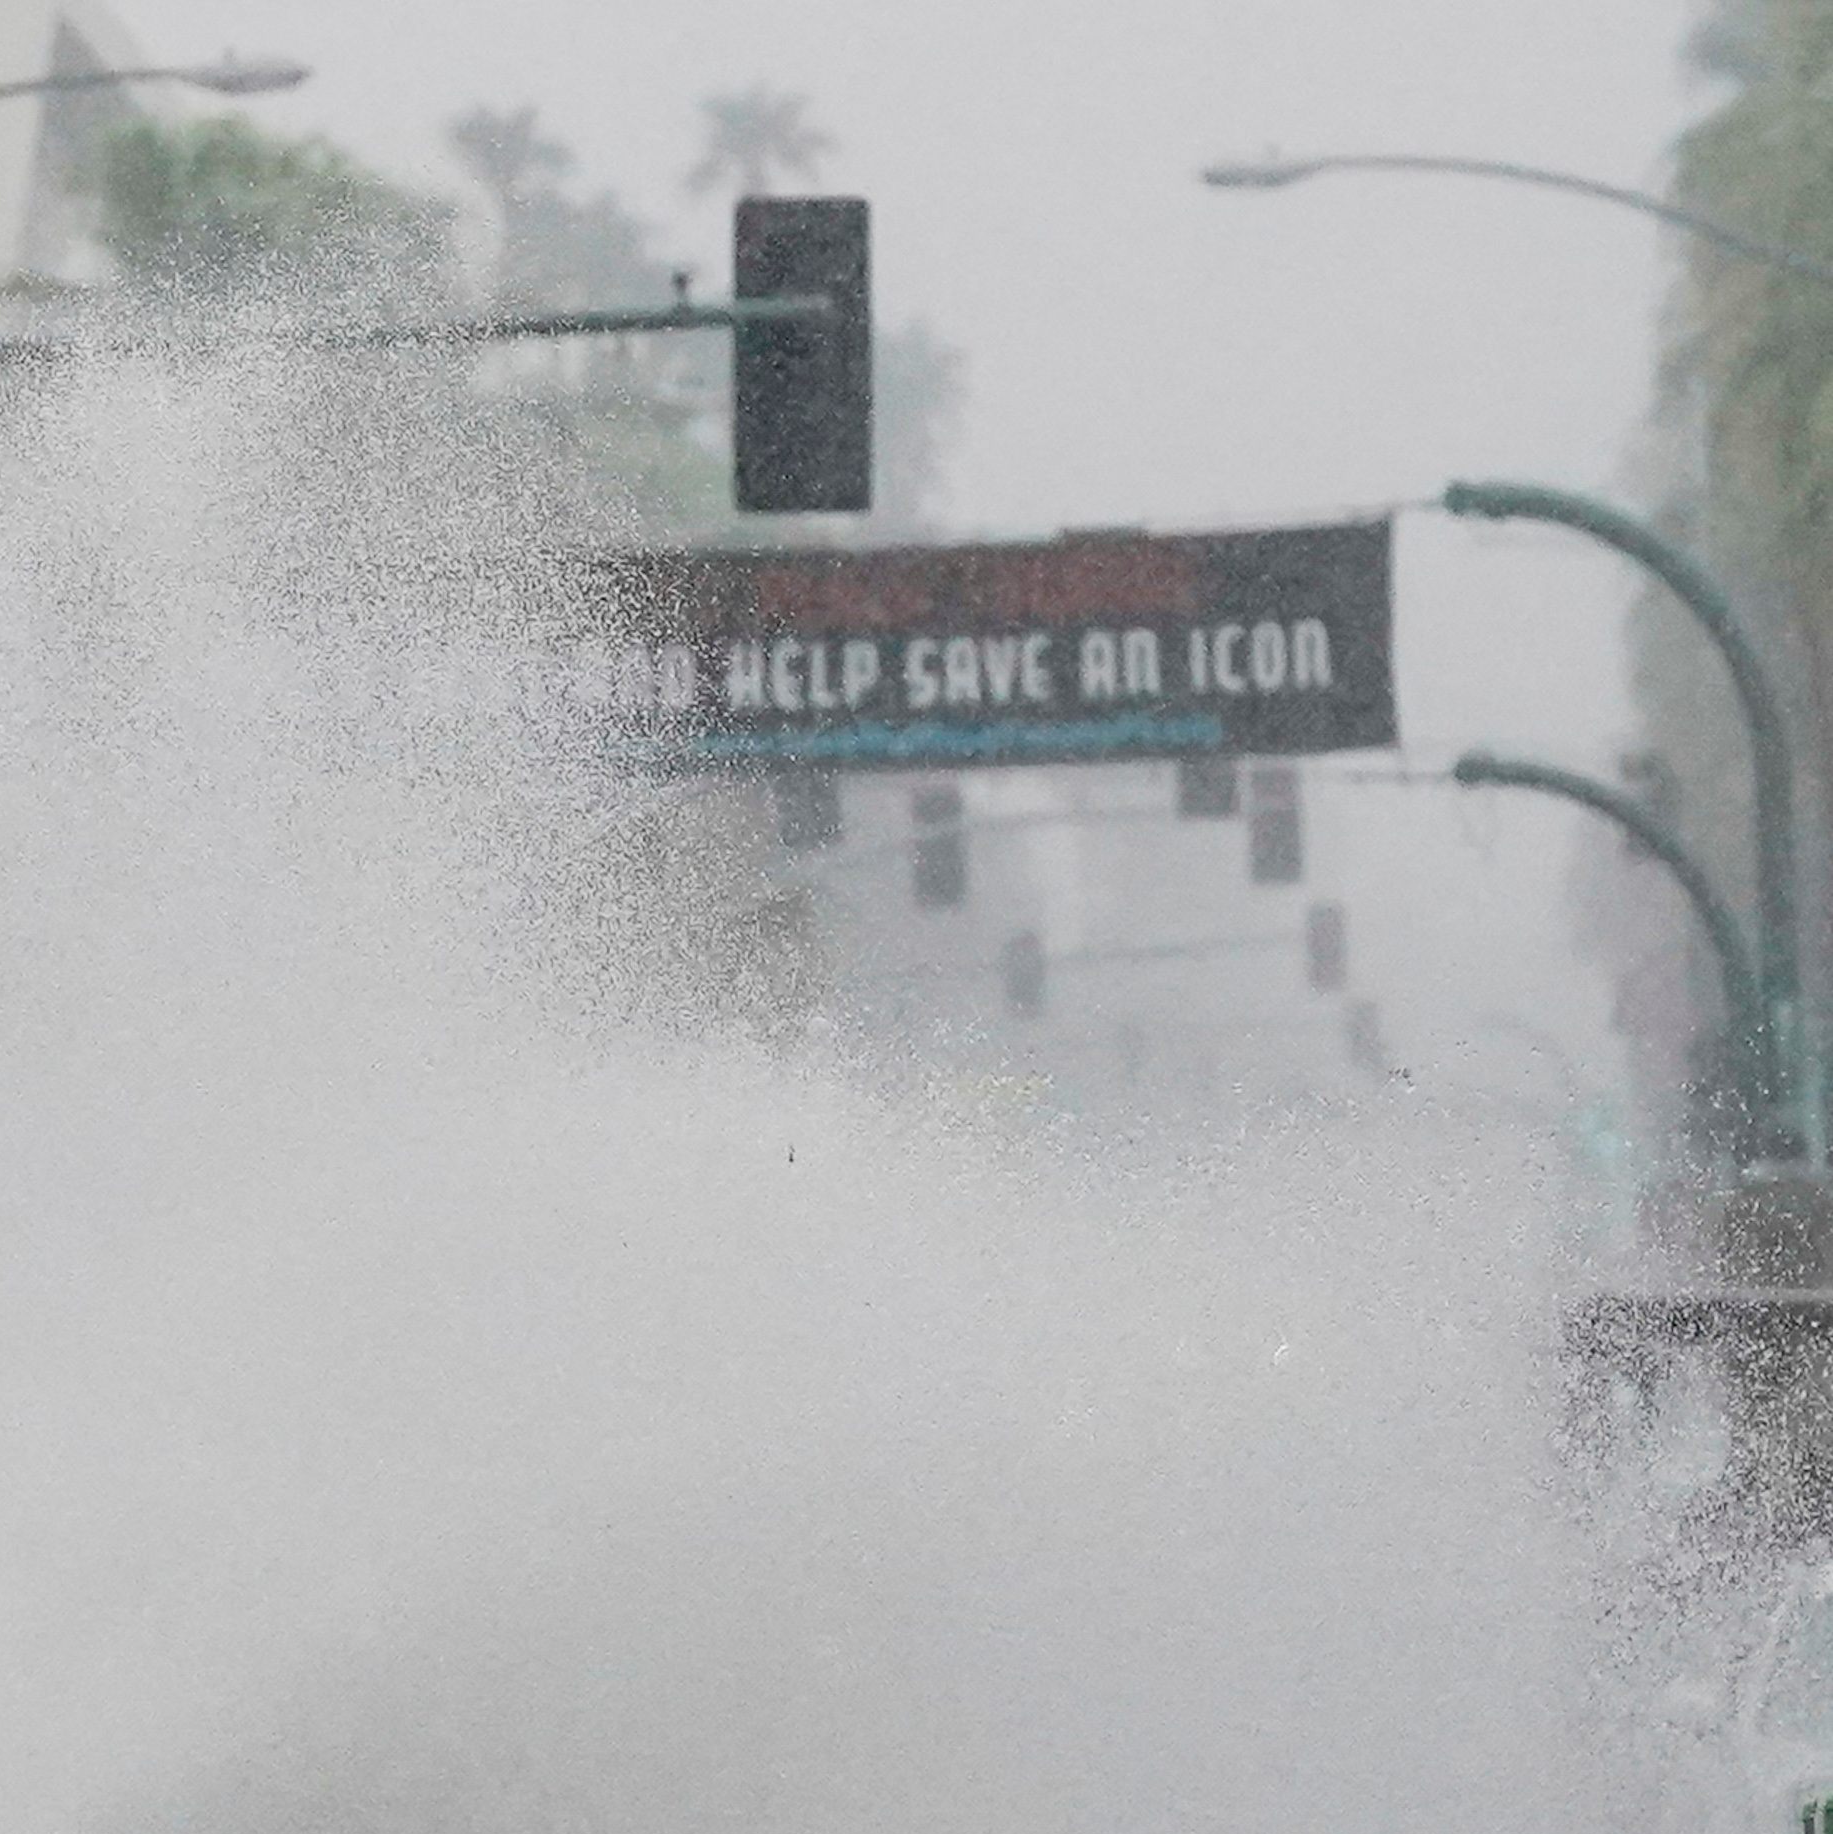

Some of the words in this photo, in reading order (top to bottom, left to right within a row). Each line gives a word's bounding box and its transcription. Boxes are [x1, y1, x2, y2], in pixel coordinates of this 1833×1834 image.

[727, 640, 880, 710] HELP
[904, 634, 1052, 706] SAVE
[1079, 627, 1162, 698] AN
[1189, 617, 1333, 695] ICON
